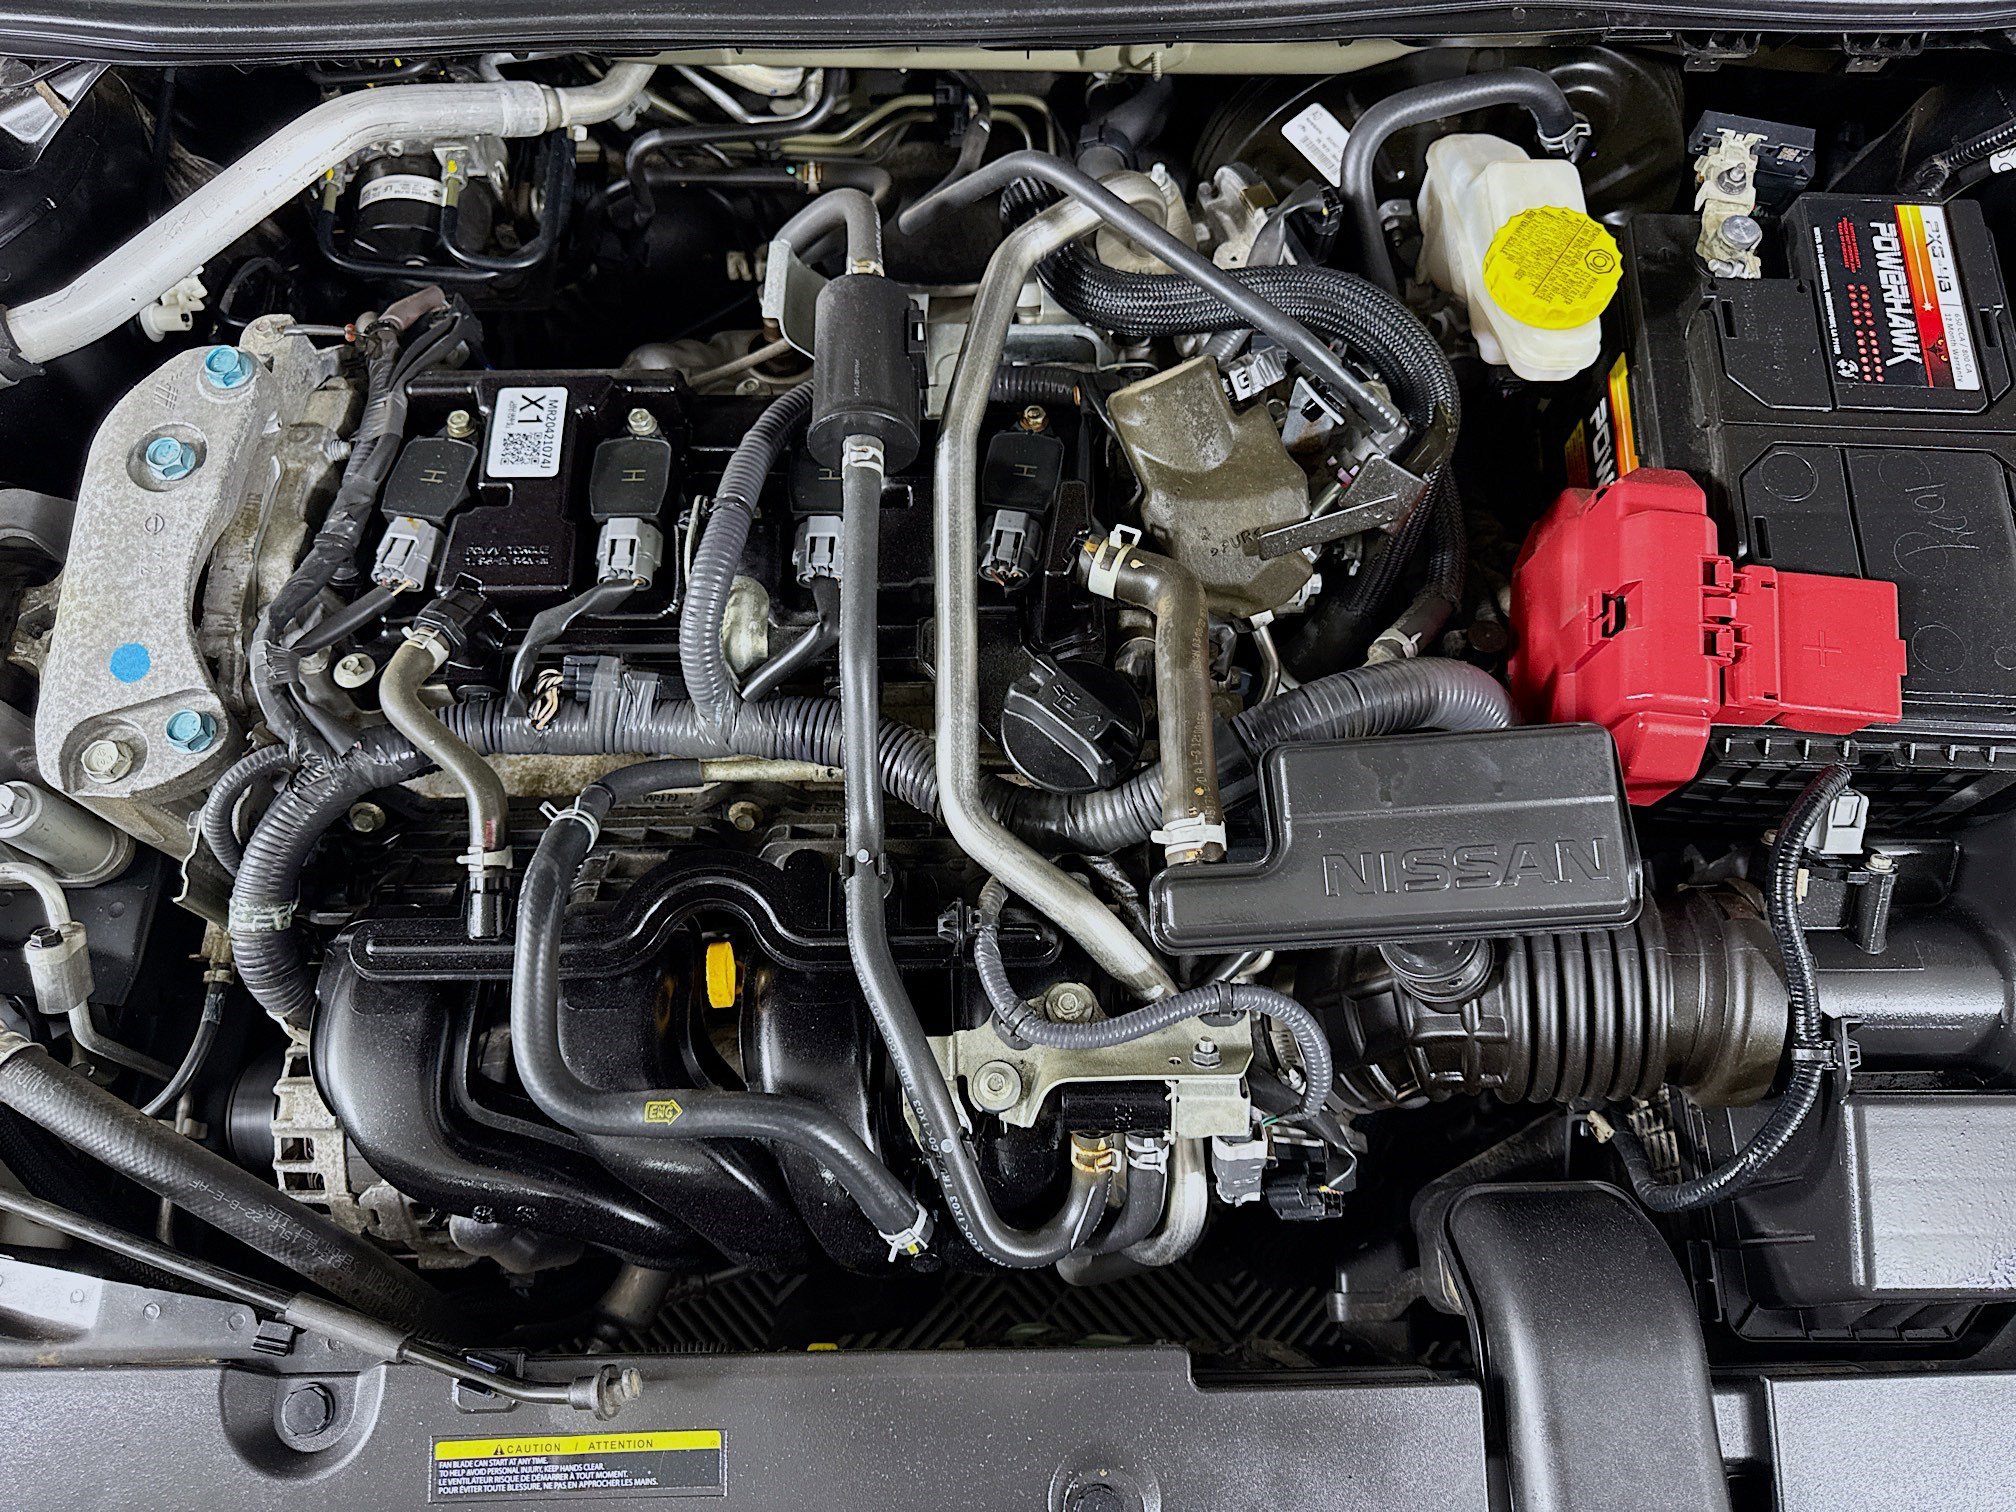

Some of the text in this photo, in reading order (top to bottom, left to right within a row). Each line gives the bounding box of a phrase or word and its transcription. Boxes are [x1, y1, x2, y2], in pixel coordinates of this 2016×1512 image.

[1869, 222, 1922, 366] POWERHAWK
[1946, 323, 1956, 346] Month
[1951, 348, 1964, 383] Warranty
[1957, 327, 1965, 341] CCA
[1964, 362, 1972, 373] CA
[517, 394, 547, 423] X1
[540, 399, 559, 469] MR20421074J
[1322, 837, 1611, 897] NISSAN
[649, 1105, 673, 1119] ENG
[507, 1443, 560, 1455] CAUTION
[588, 1439, 653, 1451] ATTENTION
[439, 1461, 452, 1469] FAN
[453, 1459, 474, 1468] BLADE
[474, 1459, 488, 1468] CAN
[489, 1458, 508, 1467] START
[508, 1458, 517, 1466] AT
[440, 1469, 449, 1477] TO
[449, 1469, 466, 1477] HELP
[466, 1468, 487, 1476] AVOID
[487, 1466, 520, 1475] PERSONAL
[544, 1465, 560, 1473] KEEP
[560, 1464, 583, 1473] HANDS
[583, 1463, 605, 1471] CLEAR.
[439, 1478, 448, 1486] LE
[448, 1476, 494, 1486] VENTILATEUR
[494, 1475, 520, 1484] RISQUE
[531, 1472, 569, 1482] DÉMARRER
[576, 1471, 595, 1480] TOUT
[595, 1470, 629, 1479] MOMENT.
[439, 1477, 659, 1495] POUR ÉVITER TOUTE BLESSURE, NE PAS EN APPROCHER LES MAINS.
